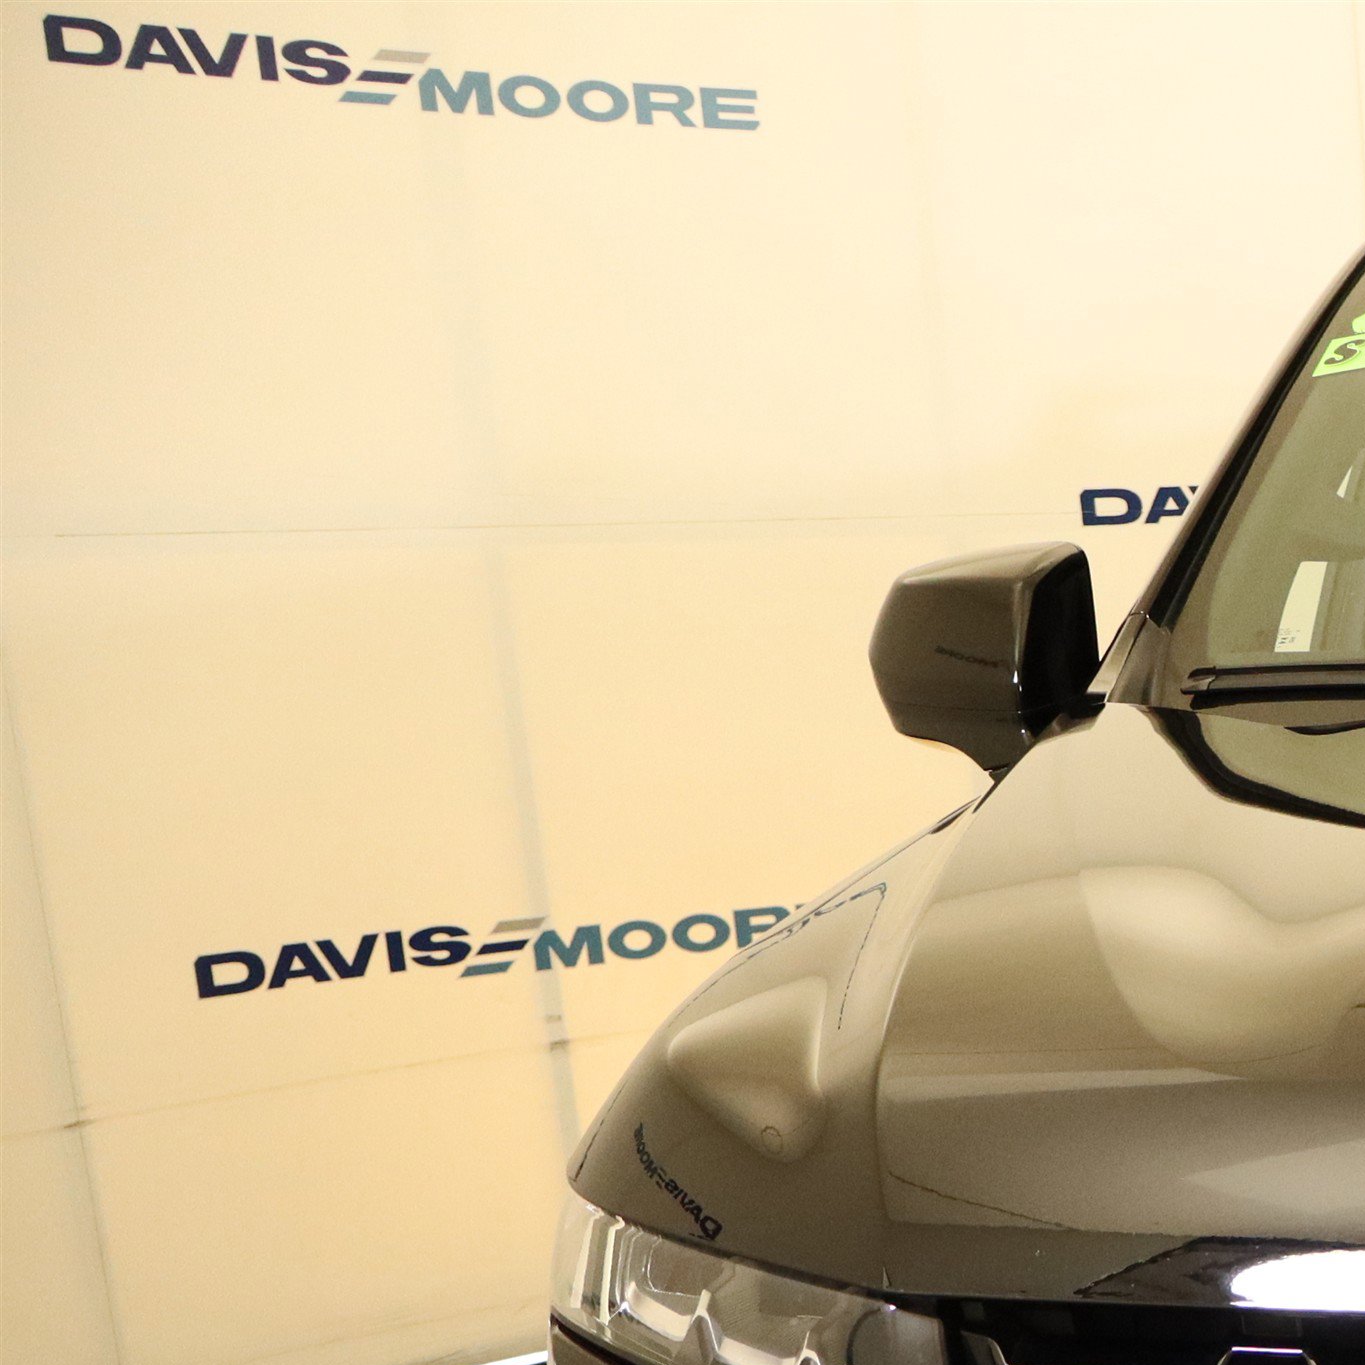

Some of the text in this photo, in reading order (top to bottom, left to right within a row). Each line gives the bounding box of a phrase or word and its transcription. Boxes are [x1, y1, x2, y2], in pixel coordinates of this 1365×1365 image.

[42, 14, 761, 132] DAVIS MOORE
[194, 904, 805, 999] DAVIS MOOR
